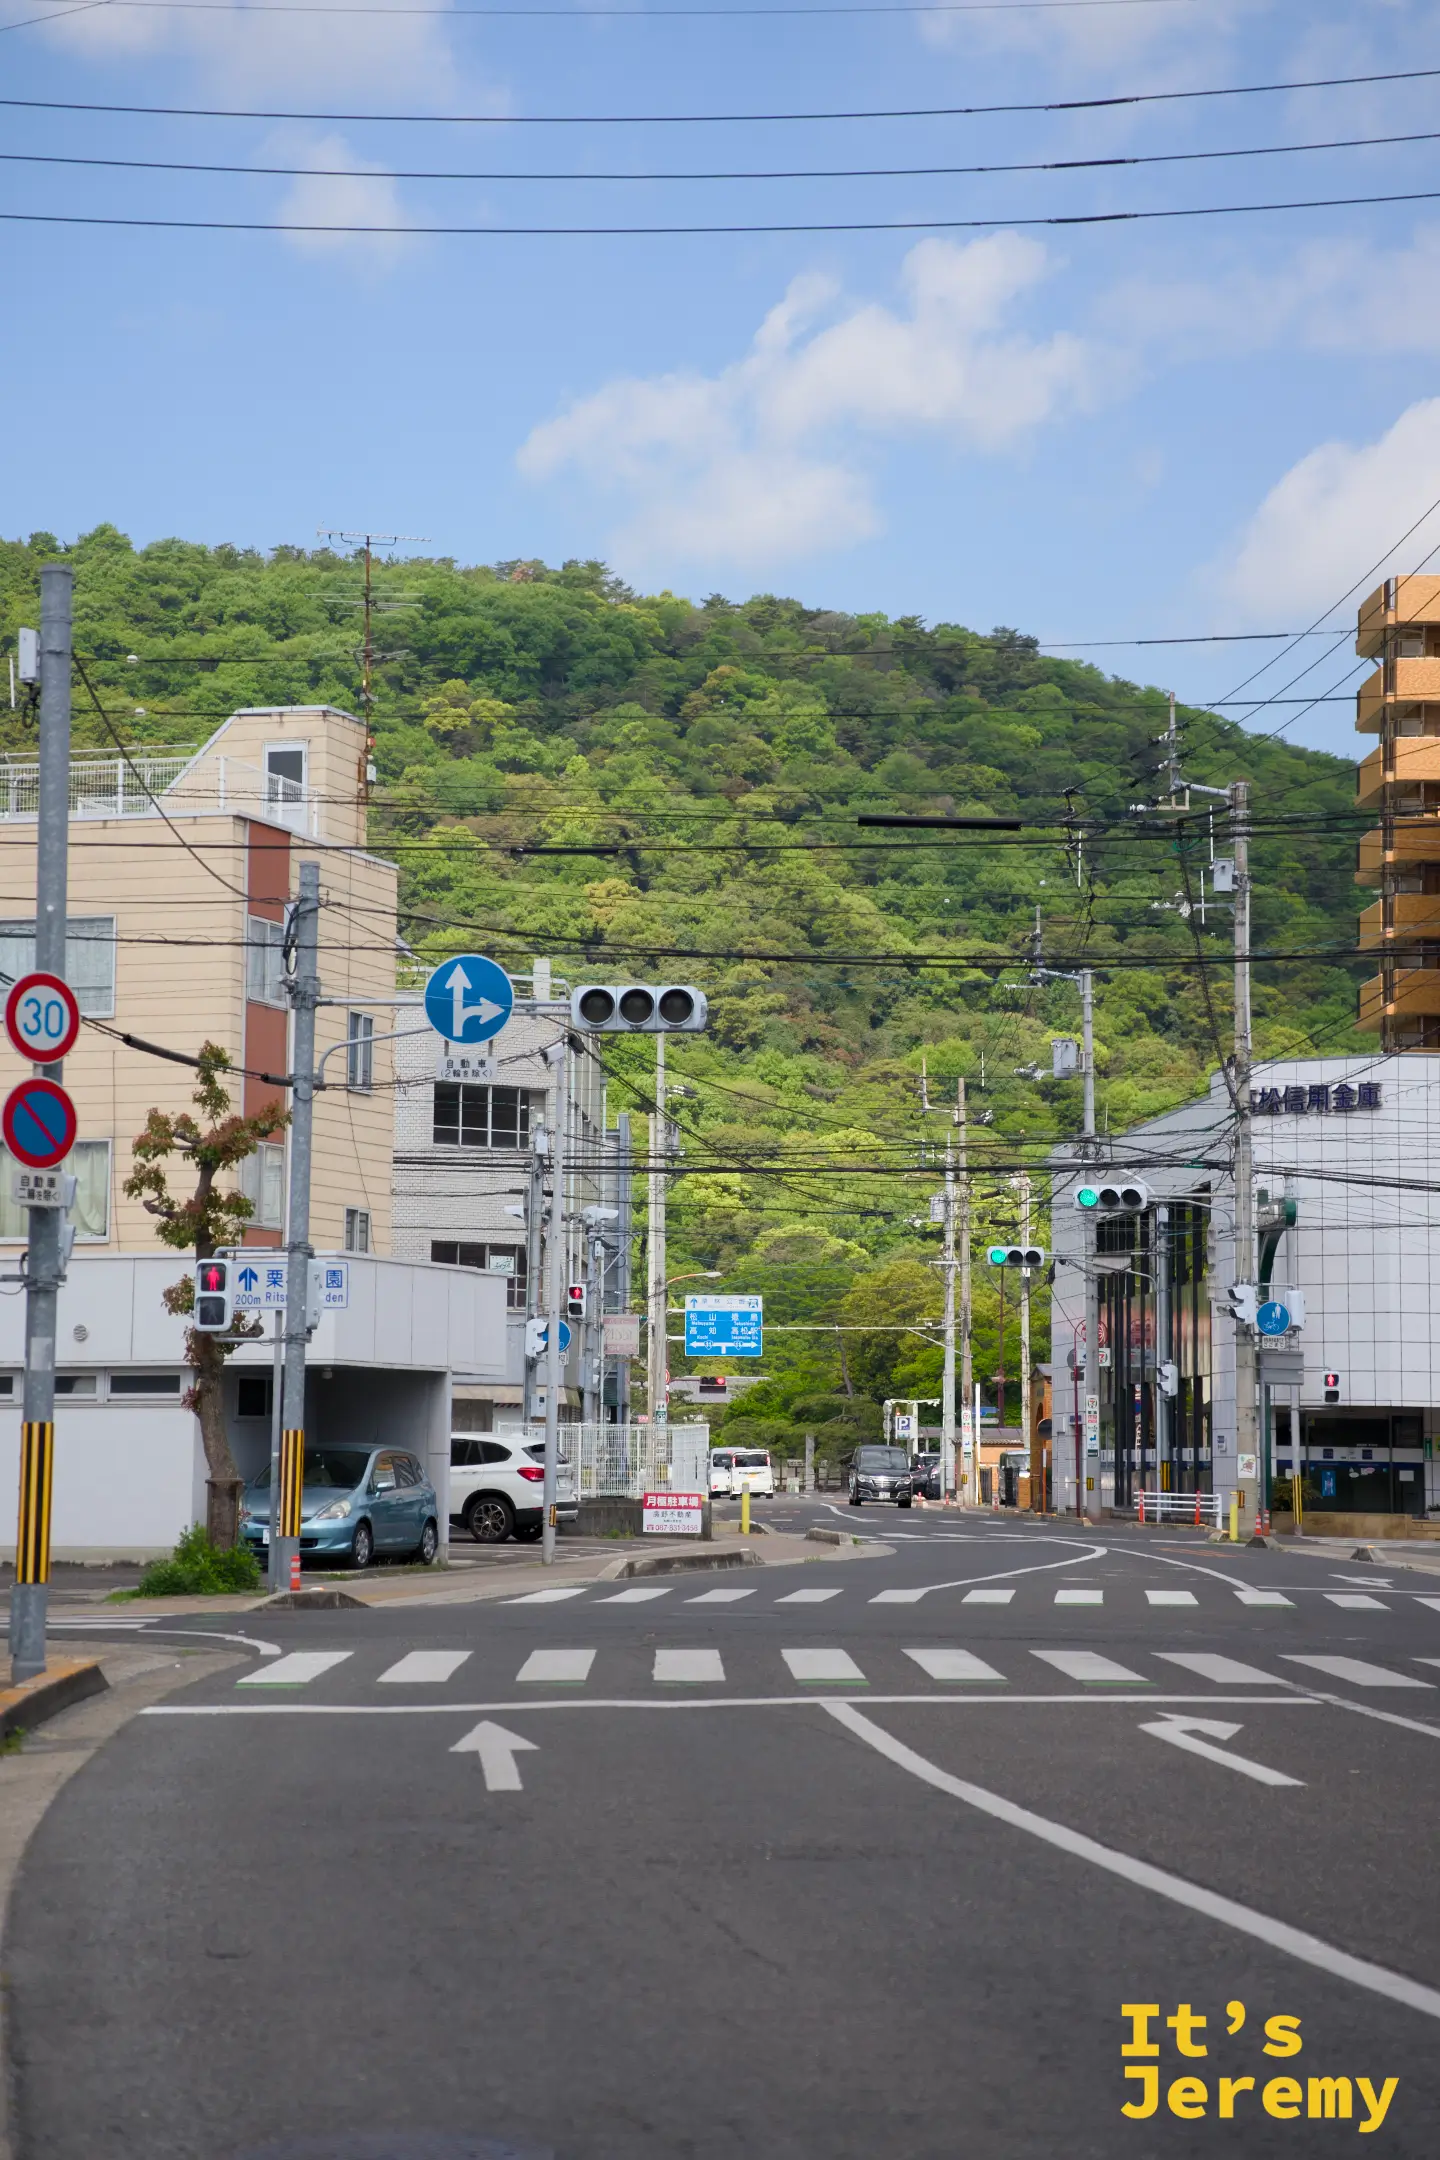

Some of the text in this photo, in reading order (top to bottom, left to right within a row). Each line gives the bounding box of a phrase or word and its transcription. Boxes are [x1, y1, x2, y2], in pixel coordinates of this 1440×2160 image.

[24, 998, 64, 1038] 30
[446, 1059, 487, 1069] 自動車
[20, 1175, 56, 1188] 自動車
[235, 1294, 261, 1304] 200m
[900, 1416, 909, 1430] P
[646, 1495, 699, 1508] 月極駐車場
